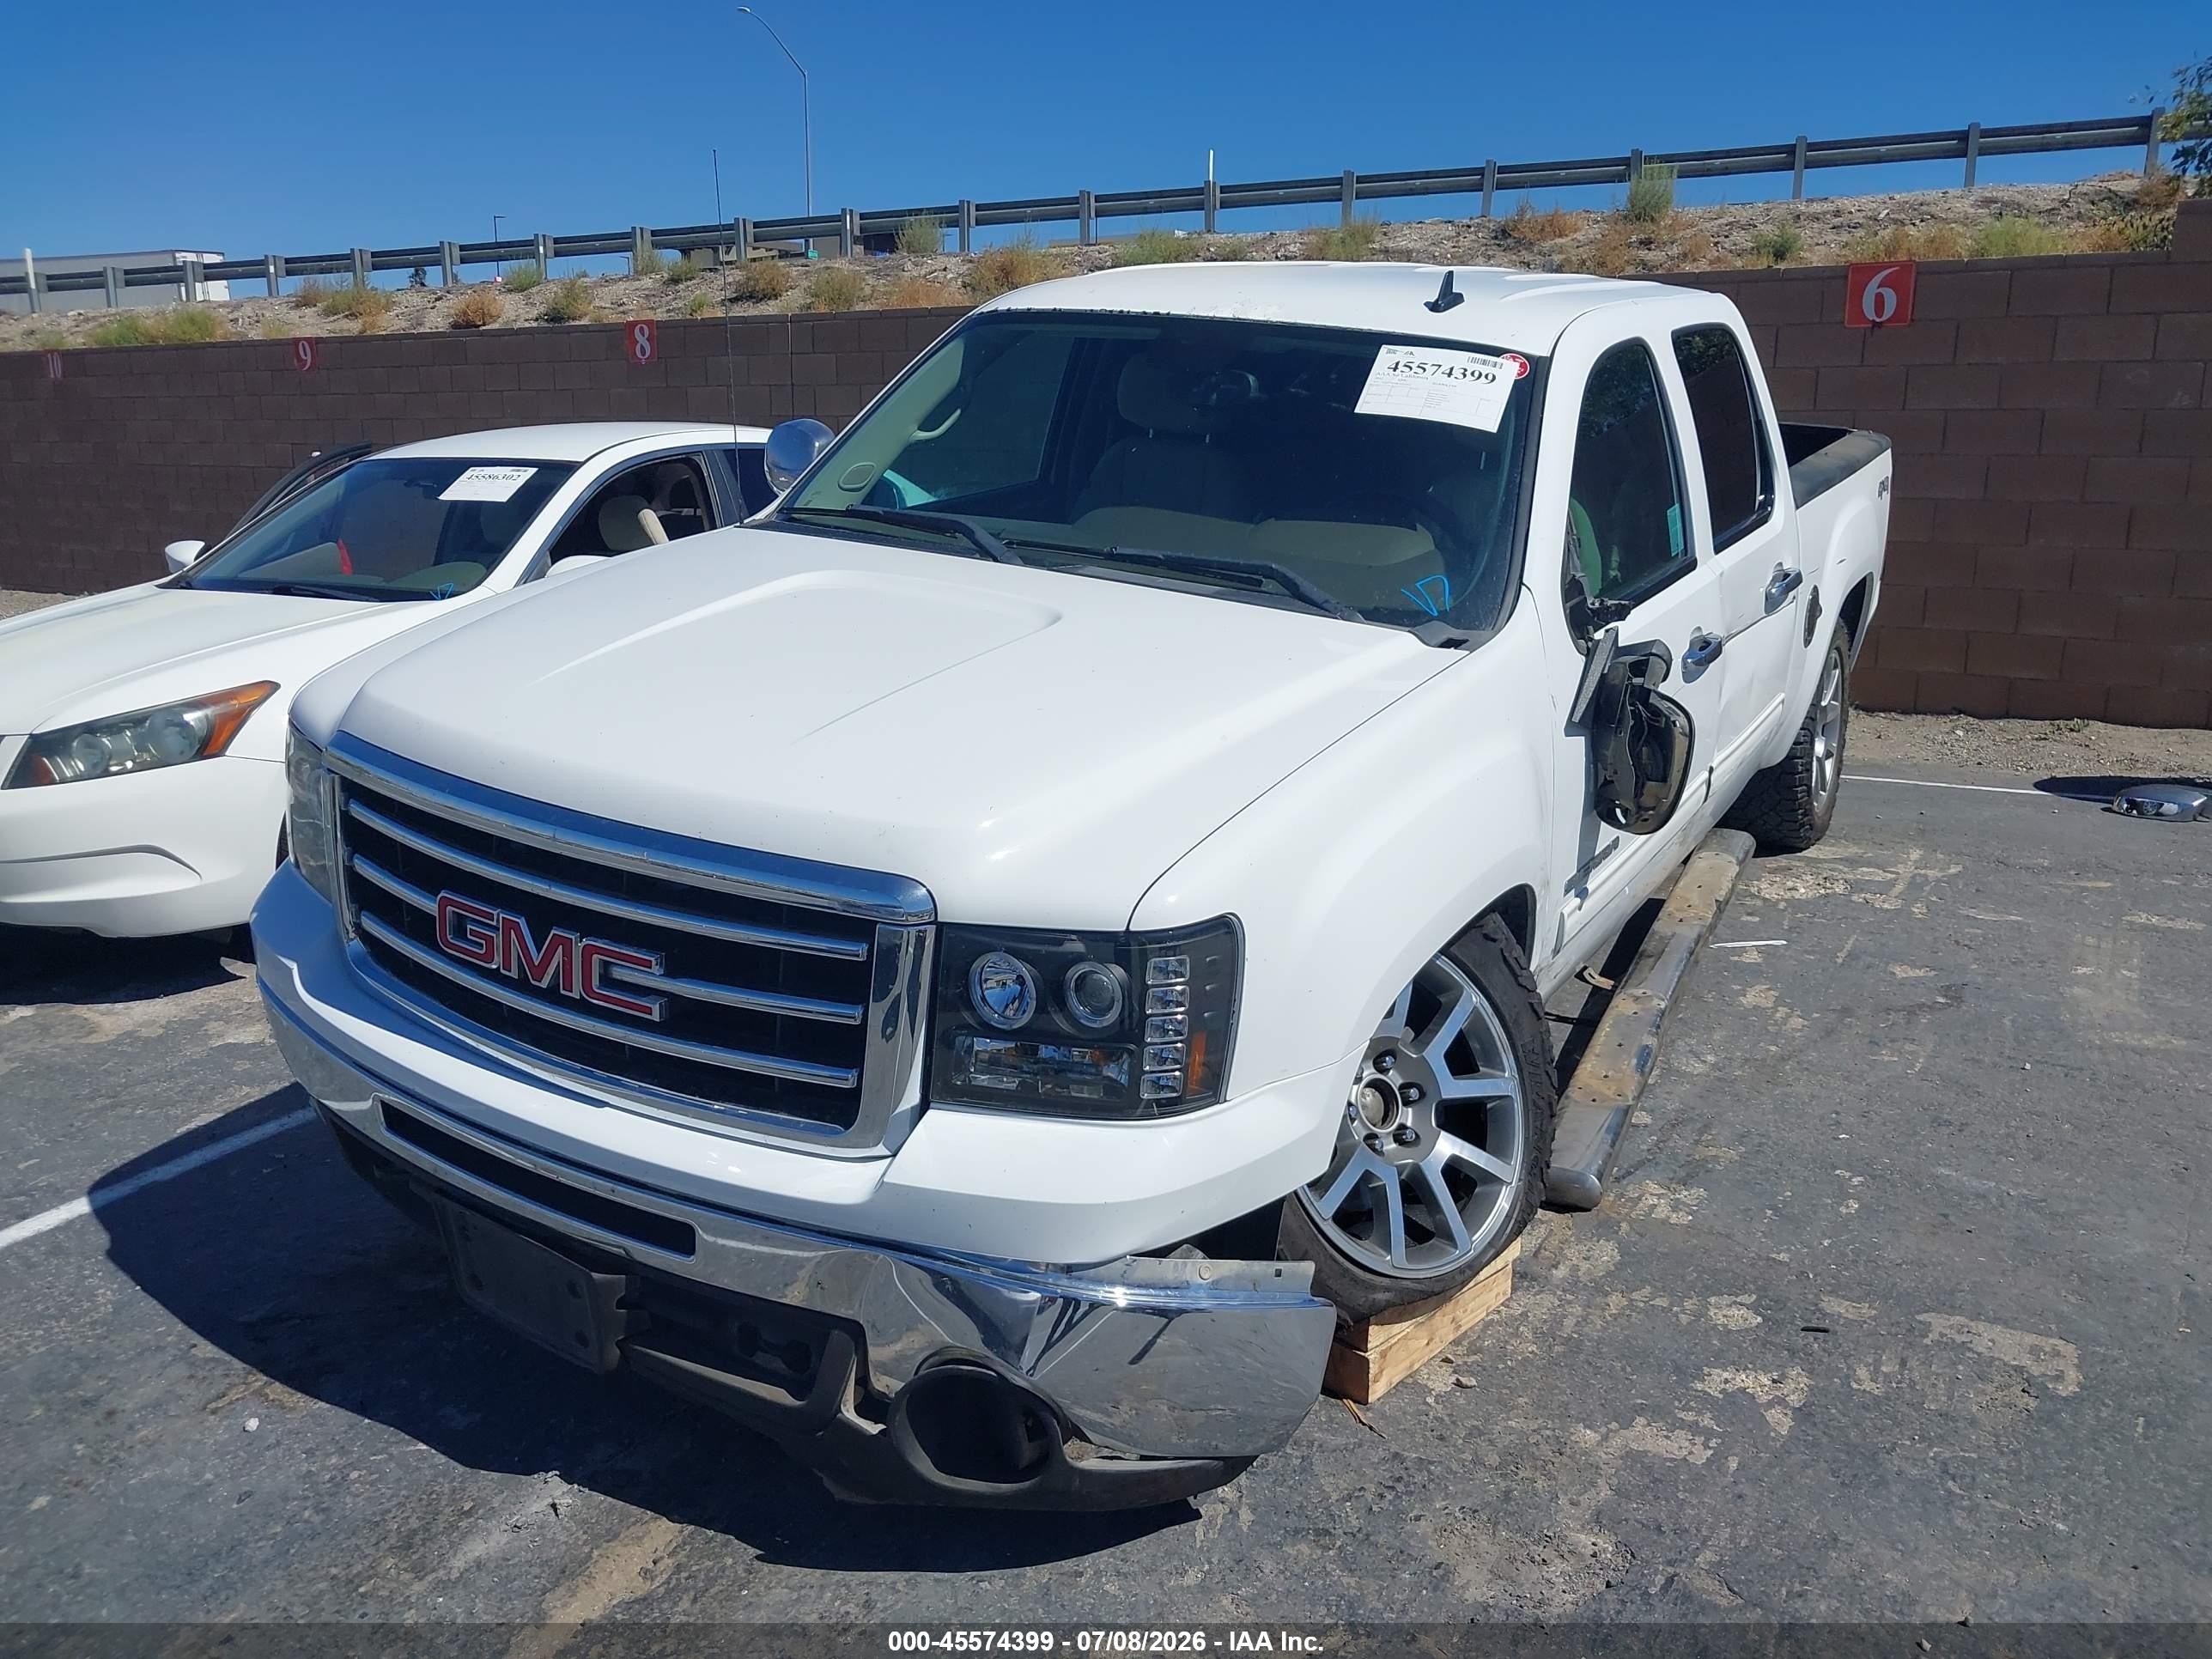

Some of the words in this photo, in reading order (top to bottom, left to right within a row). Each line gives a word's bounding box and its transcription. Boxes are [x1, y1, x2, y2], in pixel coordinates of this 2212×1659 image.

[1862, 266, 1900, 322] 6
[298, 340, 312, 371] 9
[634, 324, 651, 359] 8
[47, 352, 62, 379] 10
[1387, 360, 1497, 385] 45574399
[436, 890, 668, 1022] GMC
